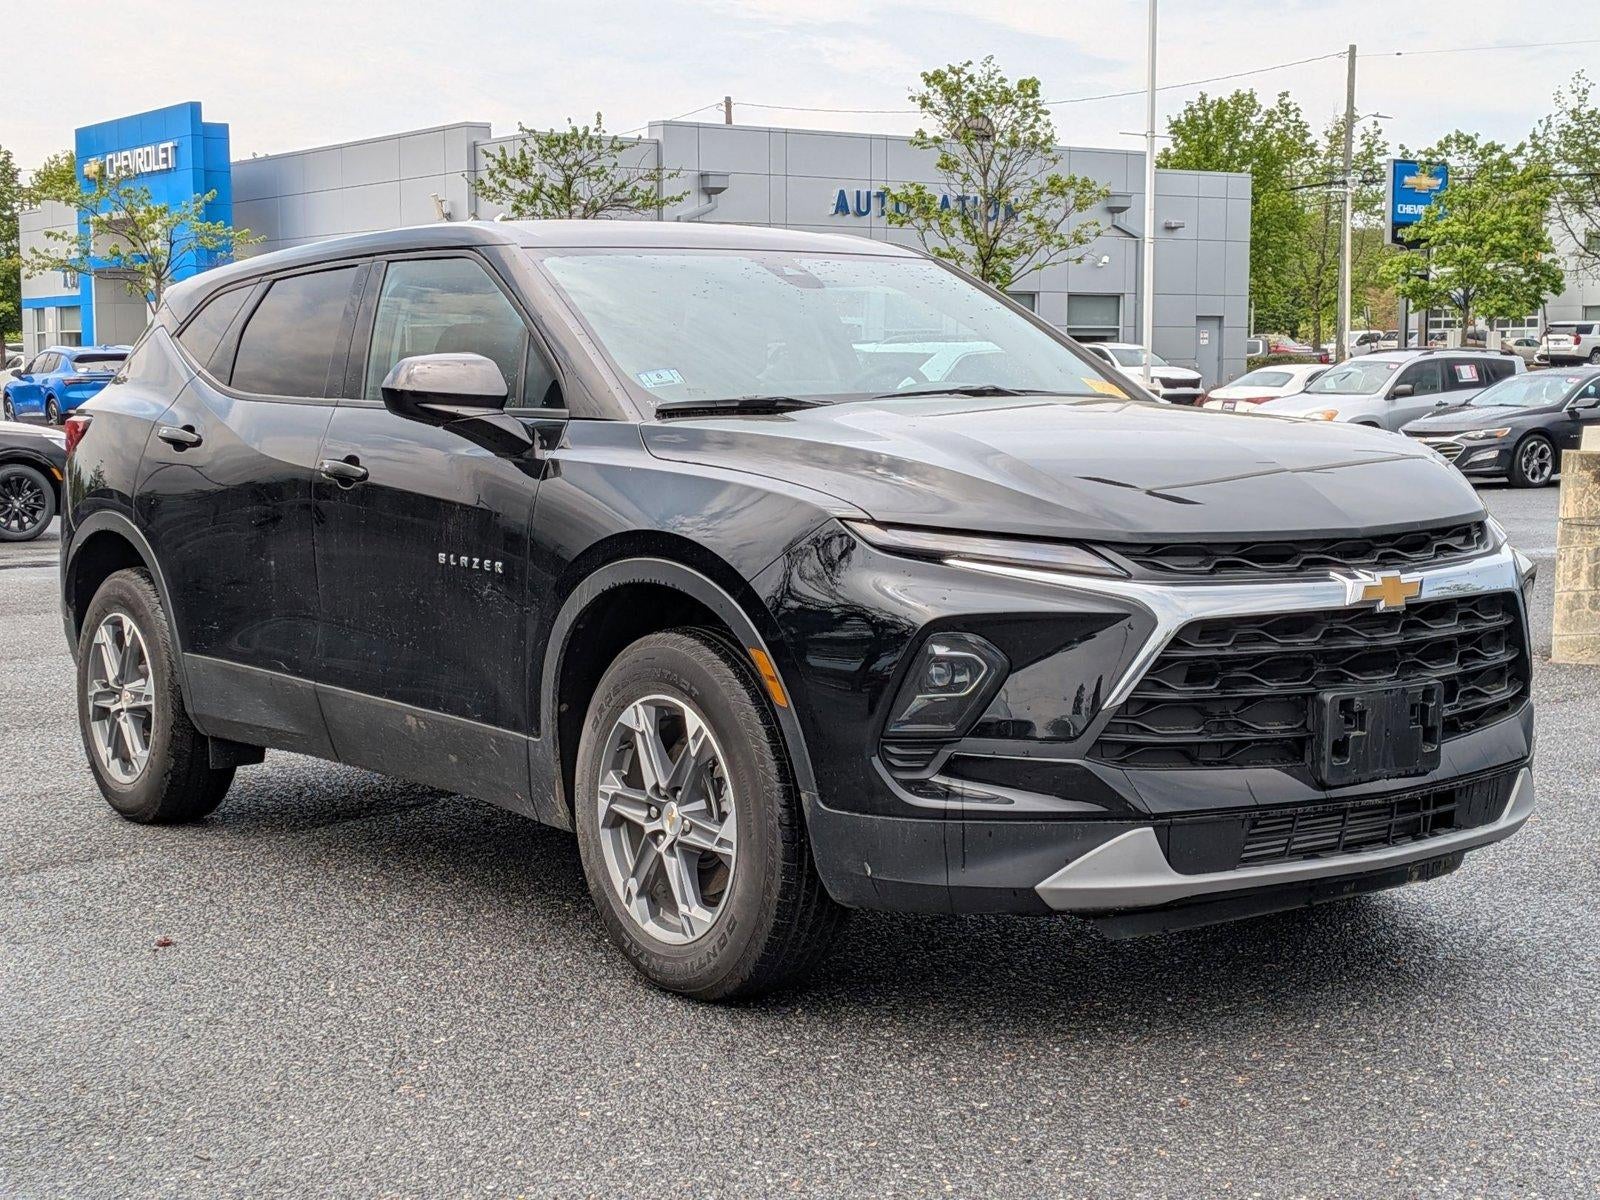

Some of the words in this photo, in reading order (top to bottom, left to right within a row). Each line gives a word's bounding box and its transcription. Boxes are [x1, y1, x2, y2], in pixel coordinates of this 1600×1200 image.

[106, 141, 175, 179] CHEVROLET
[832, 189, 1019, 222] AUTOATION
[438, 552, 503, 574] BLAZER
